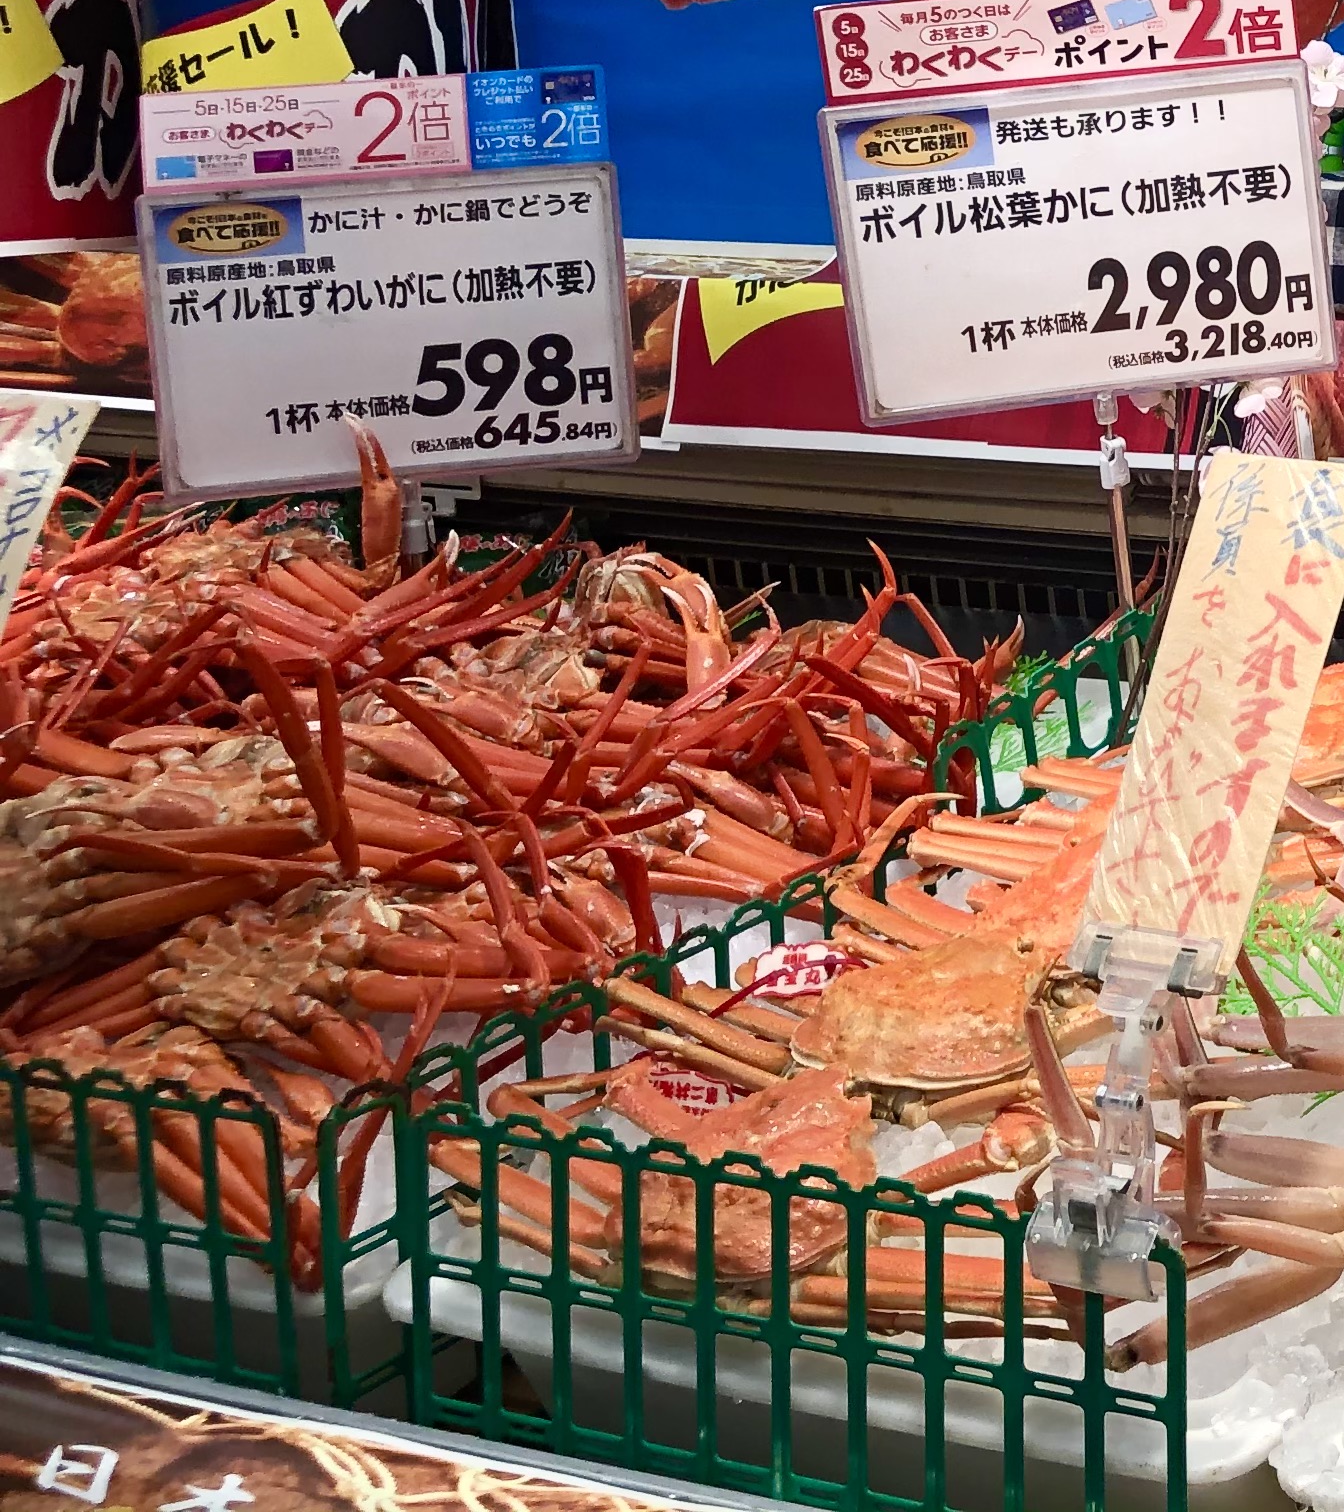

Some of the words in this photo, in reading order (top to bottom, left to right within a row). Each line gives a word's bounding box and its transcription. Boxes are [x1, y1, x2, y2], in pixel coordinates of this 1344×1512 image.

[900, 3, 1012, 27] 毎月5のつく日は
[928, 23, 991, 43] お客さま
[143, 8, 301, 95] 援セール！
[890, 44, 1039, 79] わくわくデー
[1053, 35, 1169, 69] ポイント
[194, 95, 300, 119] 5日・15日・25日
[407, 88, 452, 100] ポイント
[225, 119, 330, 143] わくわくデー
[354, 90, 452, 165] 2倍
[540, 108, 601, 150] 2倍
[995, 99, 1229, 146] 発送も承ります！！
[475, 134, 537, 150] いつでも
[864, 130, 970, 160] 食べて応援!!
[855, 167, 1026, 203] 原料原産地：鳥取県
[308, 190, 594, 235] かに汁・かに鍋でどうぞ
[859, 163, 1294, 244] ボイル松葉かに（加熱不要）
[176, 218, 281, 246] 食べて応援!!
[165, 256, 337, 286] 原料原産地：鳥取県
[168, 258, 598, 328] ボイル紅ずわいがに（加熱不要）
[961, 321, 1016, 354] 1杯
[1020, 309, 1089, 339] 本体価格
[1087, 239, 1315, 335] 2,980円
[264, 402, 319, 436] 1杯
[325, 393, 411, 424] 本体価格
[410, 332, 615, 419] 598円
